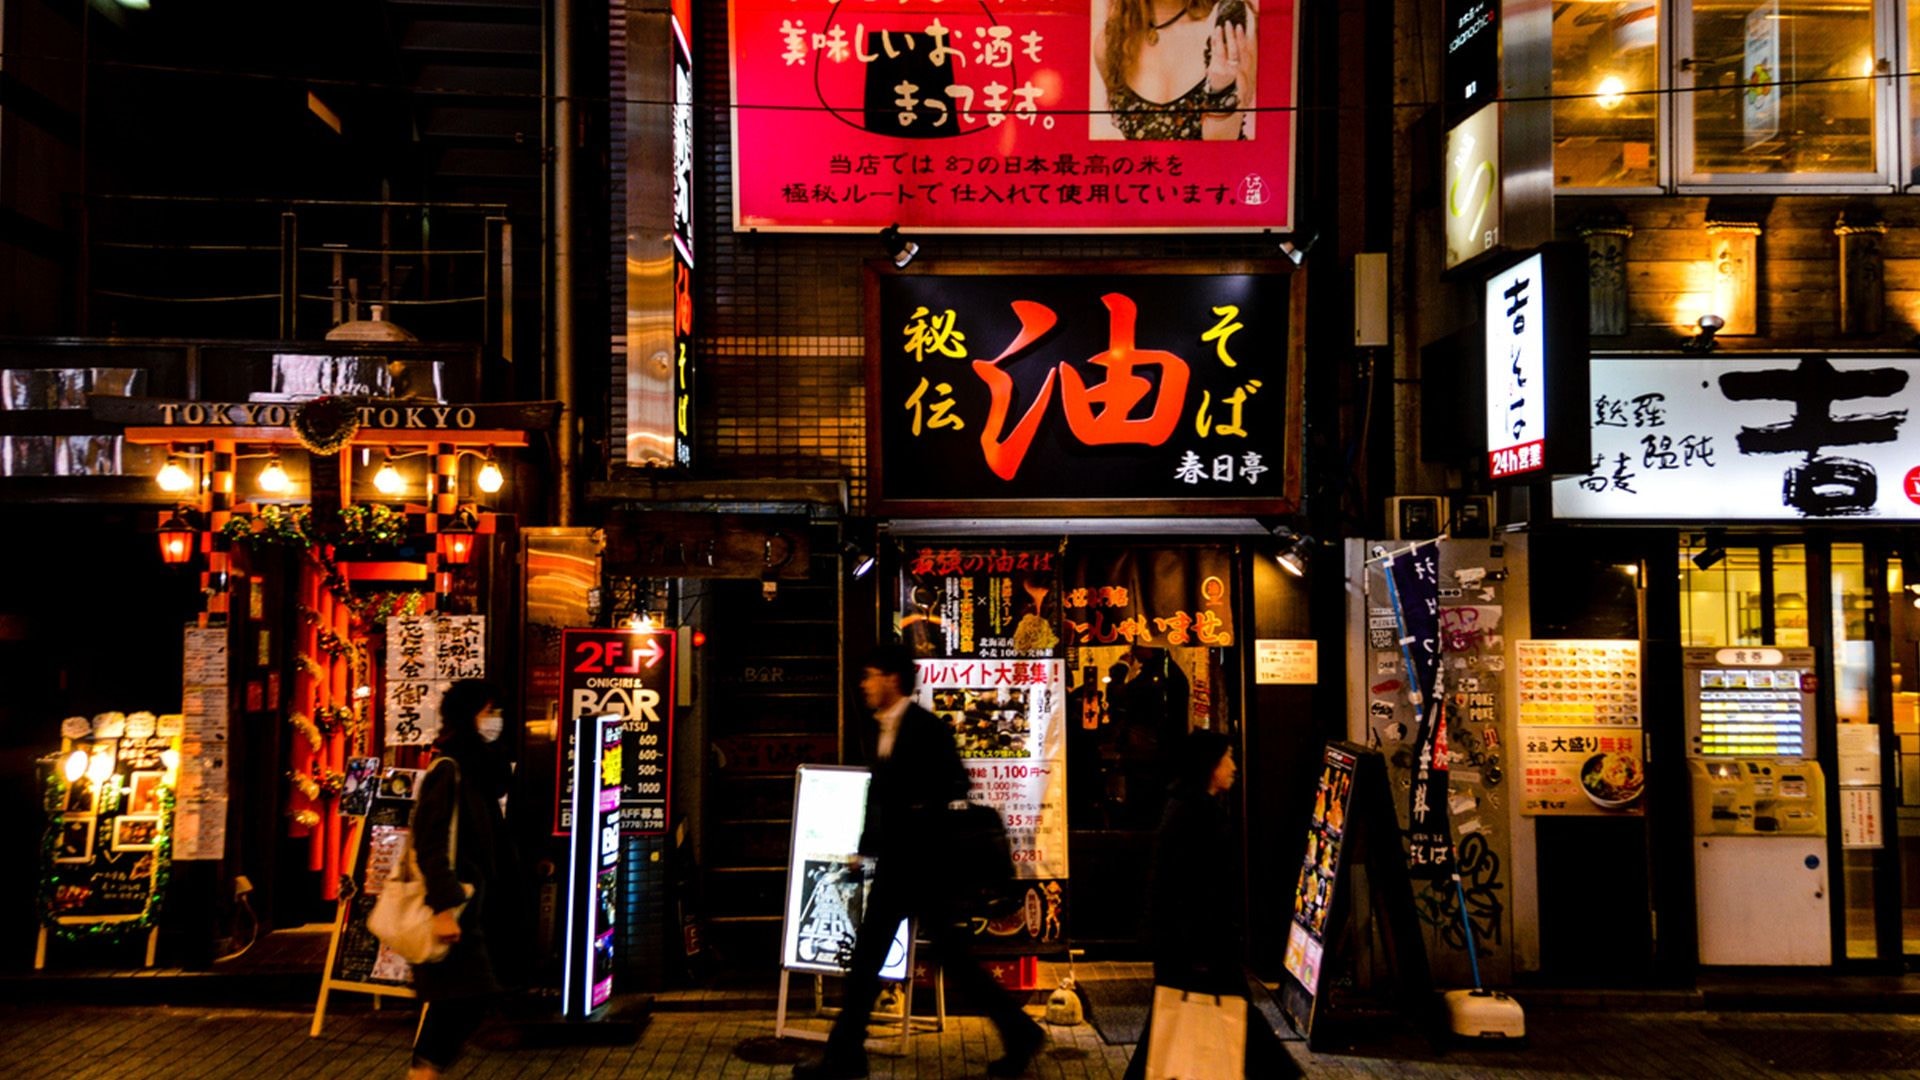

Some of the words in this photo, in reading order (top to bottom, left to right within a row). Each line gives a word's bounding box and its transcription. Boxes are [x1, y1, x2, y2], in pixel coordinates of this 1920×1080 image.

[779, 18, 1043, 67] 美味しいお酒も
[895, 81, 1056, 129] まってます。
[1484, 227, 1499, 249] B1
[903, 306, 968, 436] 秘伝
[971, 292, 1190, 481] 油
[1196, 304, 1263, 438] そば
[159, 402, 287, 427] TOKYO
[356, 405, 478, 429] TOKYO
[1718, 358, 1910, 516] 吉
[1173, 450, 1269, 485] 春日亭
[1492, 442, 1542, 476] 24h営業
[911, 546, 1055, 576] 最強の油そば
[399, 616, 425, 678] 忘年会
[574, 640, 625, 673] 2F
[571, 687, 661, 723] BAR
[637, 735, 658, 745] 600
[637, 782, 661, 794] 1000
[992, 765, 1028, 780] 1,100
[1007, 815, 1022, 826] 35
[1012, 849, 1043, 863] 6281
